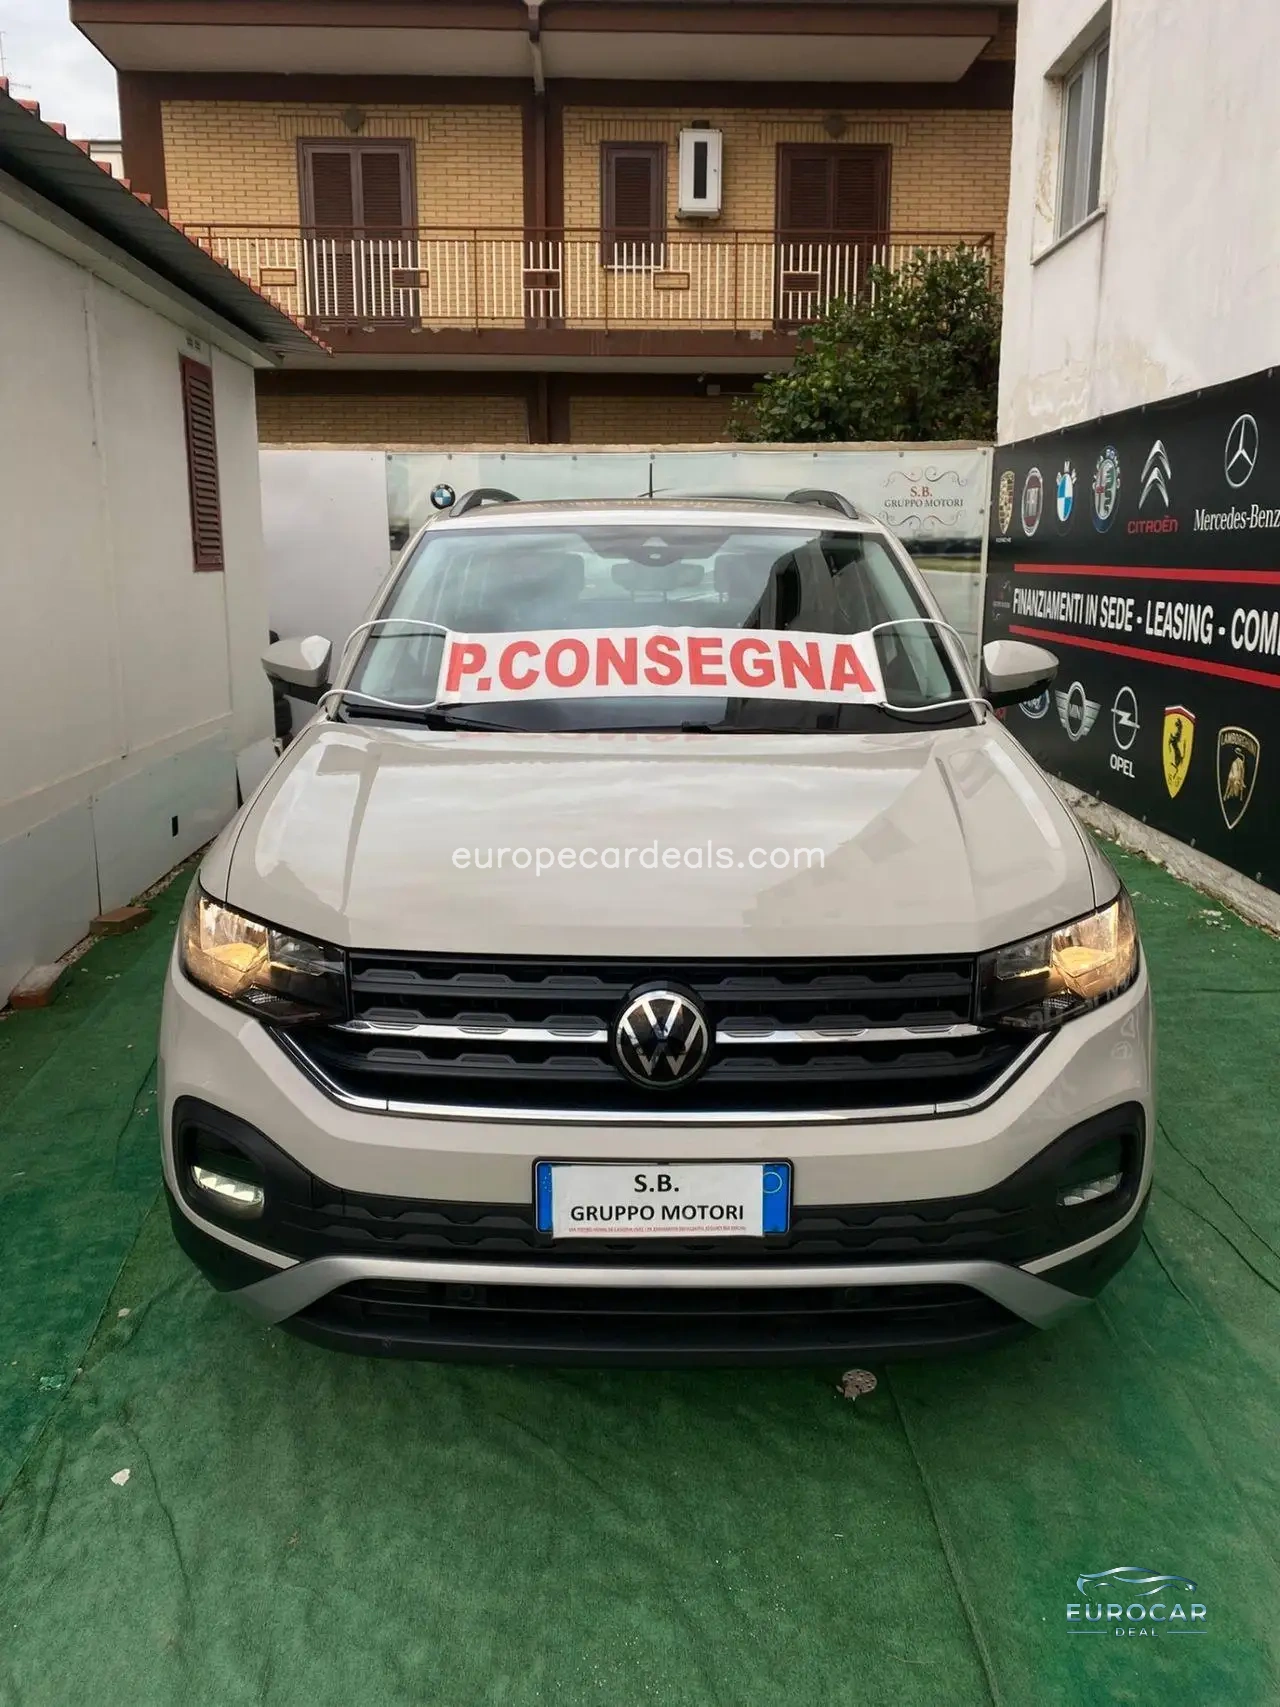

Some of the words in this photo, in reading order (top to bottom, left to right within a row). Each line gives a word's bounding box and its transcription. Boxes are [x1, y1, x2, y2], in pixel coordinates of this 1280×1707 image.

[910, 486, 932, 497] S.B.
[884, 499, 922, 508] GRUPPO
[924, 499, 964, 508] MOTORI
[1193, 504, 1280, 531] Mercedes-Benz
[1012, 588, 1084, 624] FINANZIAMENTI
[1085, 594, 1099, 626] IN
[1100, 595, 1135, 632] SEDE
[1145, 600, 1214, 645] LEASING
[1231, 608, 1280, 657] COM
[445, 635, 876, 693] P.CONSEGNA
[1110, 754, 1135, 778] OPEL
[634, 1174, 680, 1193] S.B.
[570, 1205, 655, 1221] GRUPPO
[661, 1205, 744, 1221] MOTORI
